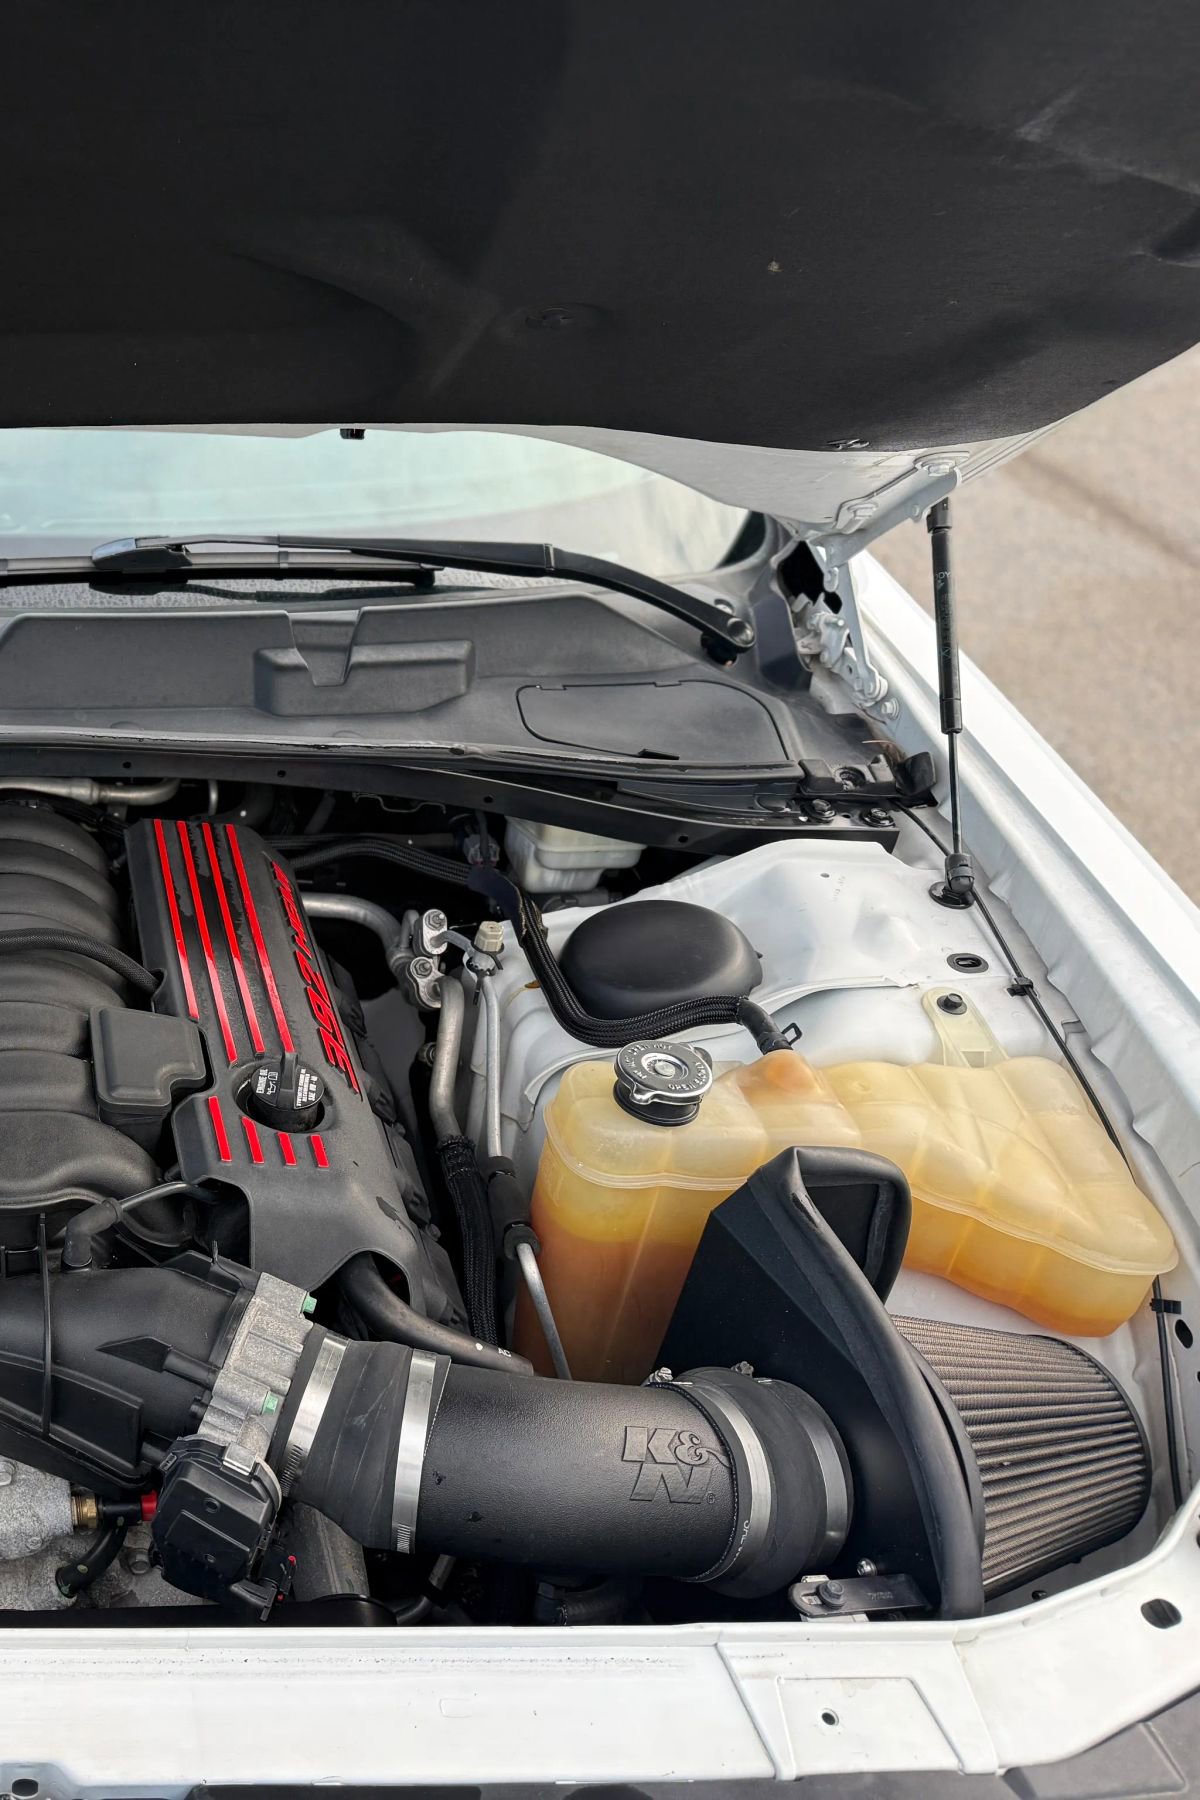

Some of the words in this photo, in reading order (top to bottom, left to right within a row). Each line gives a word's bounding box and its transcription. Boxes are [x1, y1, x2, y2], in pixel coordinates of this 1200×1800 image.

[272, 861, 313, 958] HEMI
[296, 950, 359, 1092] 392
[256, 1075, 267, 1094] ENGINE
[259, 1068, 268, 1076] OIL
